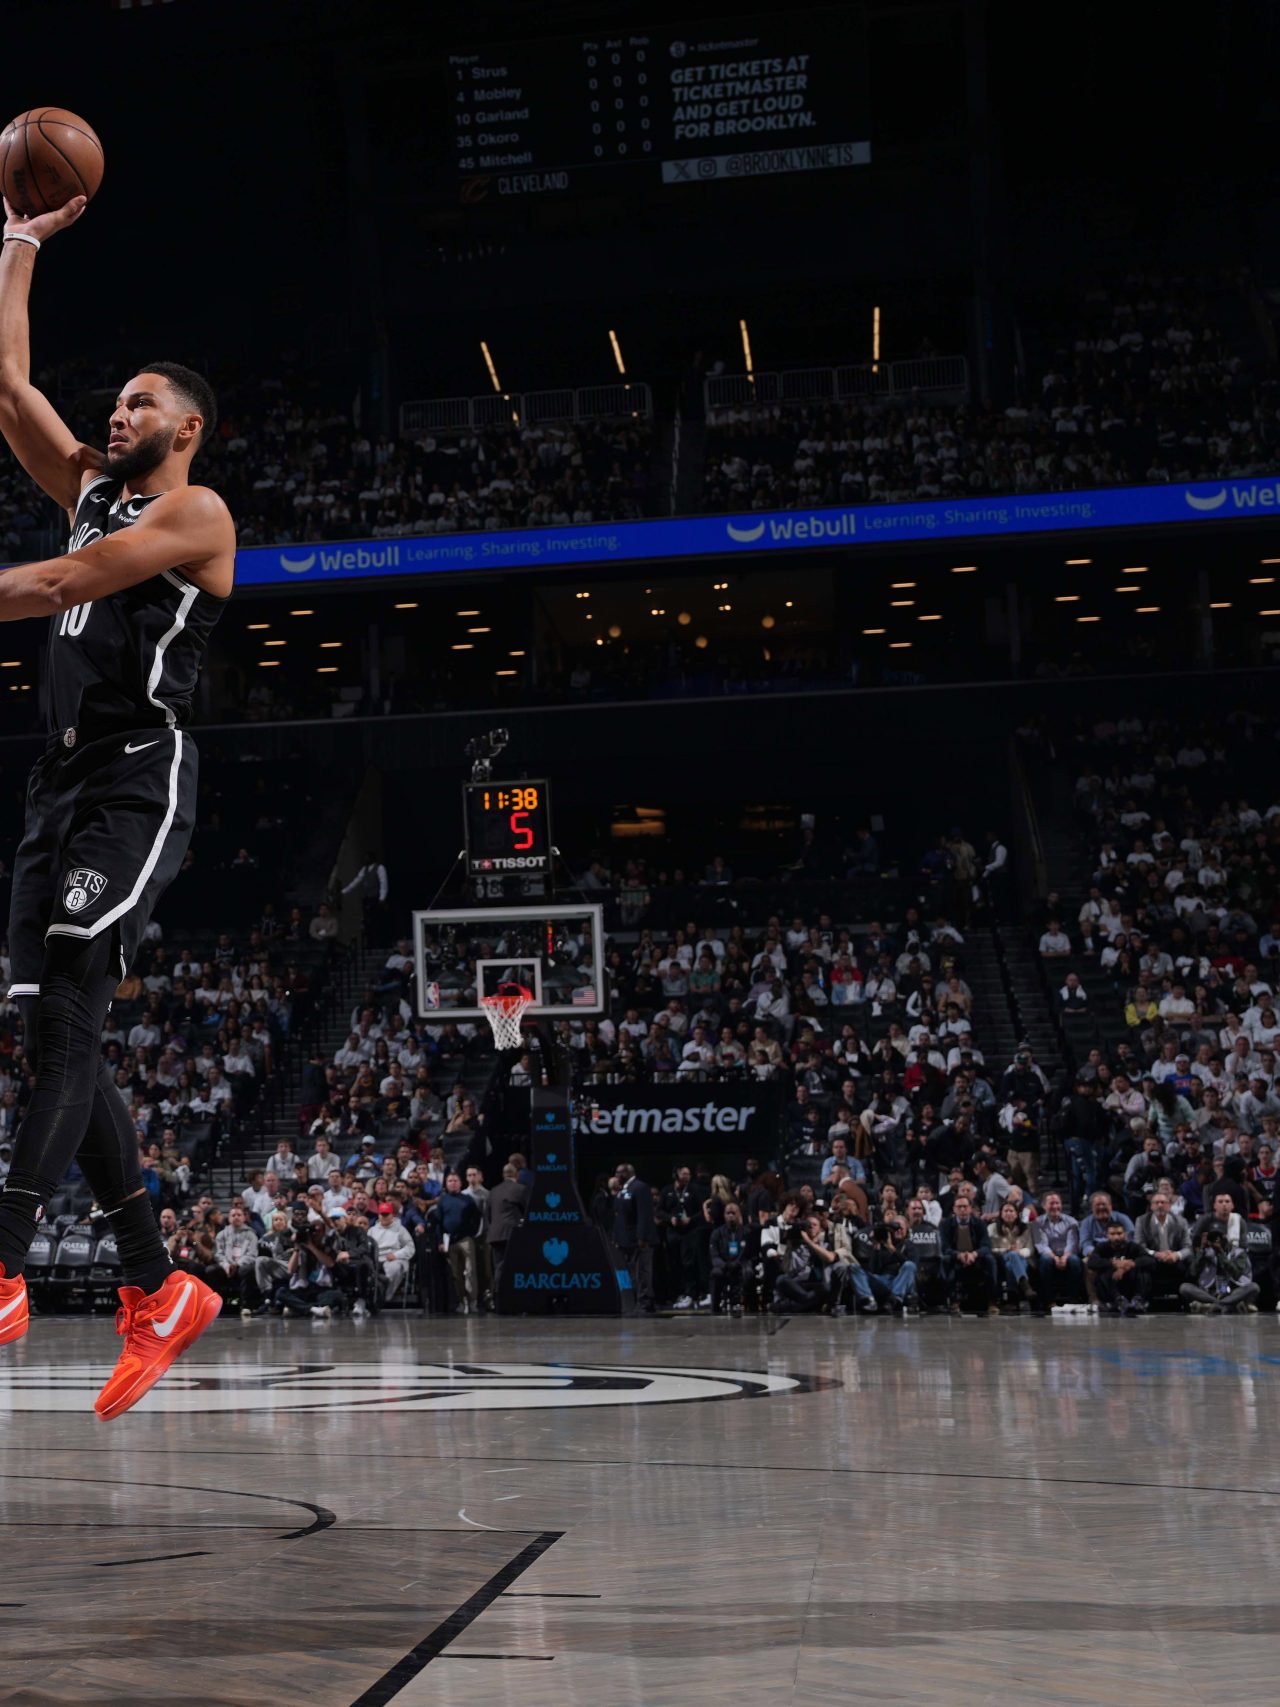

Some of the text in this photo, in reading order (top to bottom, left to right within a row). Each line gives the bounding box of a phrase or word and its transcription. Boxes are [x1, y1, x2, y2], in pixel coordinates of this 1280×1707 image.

[456, 50, 646, 81] 1 Strus 0 0 0
[671, 54, 810, 84] GET TICKETS AT
[456, 72, 647, 104] 4 Mobley 0 0 0
[672, 74, 808, 102] TICKETMASTER
[455, 95, 649, 126] 10 Garland 0 0 0
[673, 94, 804, 122] AND GET LOUD
[456, 117, 651, 148] 35 Okoro 0 0 0
[674, 111, 817, 140] FOR BROOKLYN.
[458, 140, 652, 169] 45 Mitchell 0 0 0
[726, 144, 853, 175] @BROOKLYNNETS
[497, 171, 569, 195] CLEVELAND
[770, 500, 1096, 540] Webull Learning. Sharing. Investing.
[320, 533, 620, 572] Webull Learning. Sharing. Investing.
[483, 787, 538, 811] 11:38
[510, 811, 534, 851] 5
[492, 856, 547, 869] TISSOT
[66, 870, 103, 893] NETS
[535, 1123, 566, 1132] BARCLAYS
[536, 1163, 567, 1172] BARCLAYS
[528, 1211, 581, 1222] BARCLAYS
[513, 1272, 602, 1290] BARCLAYS
